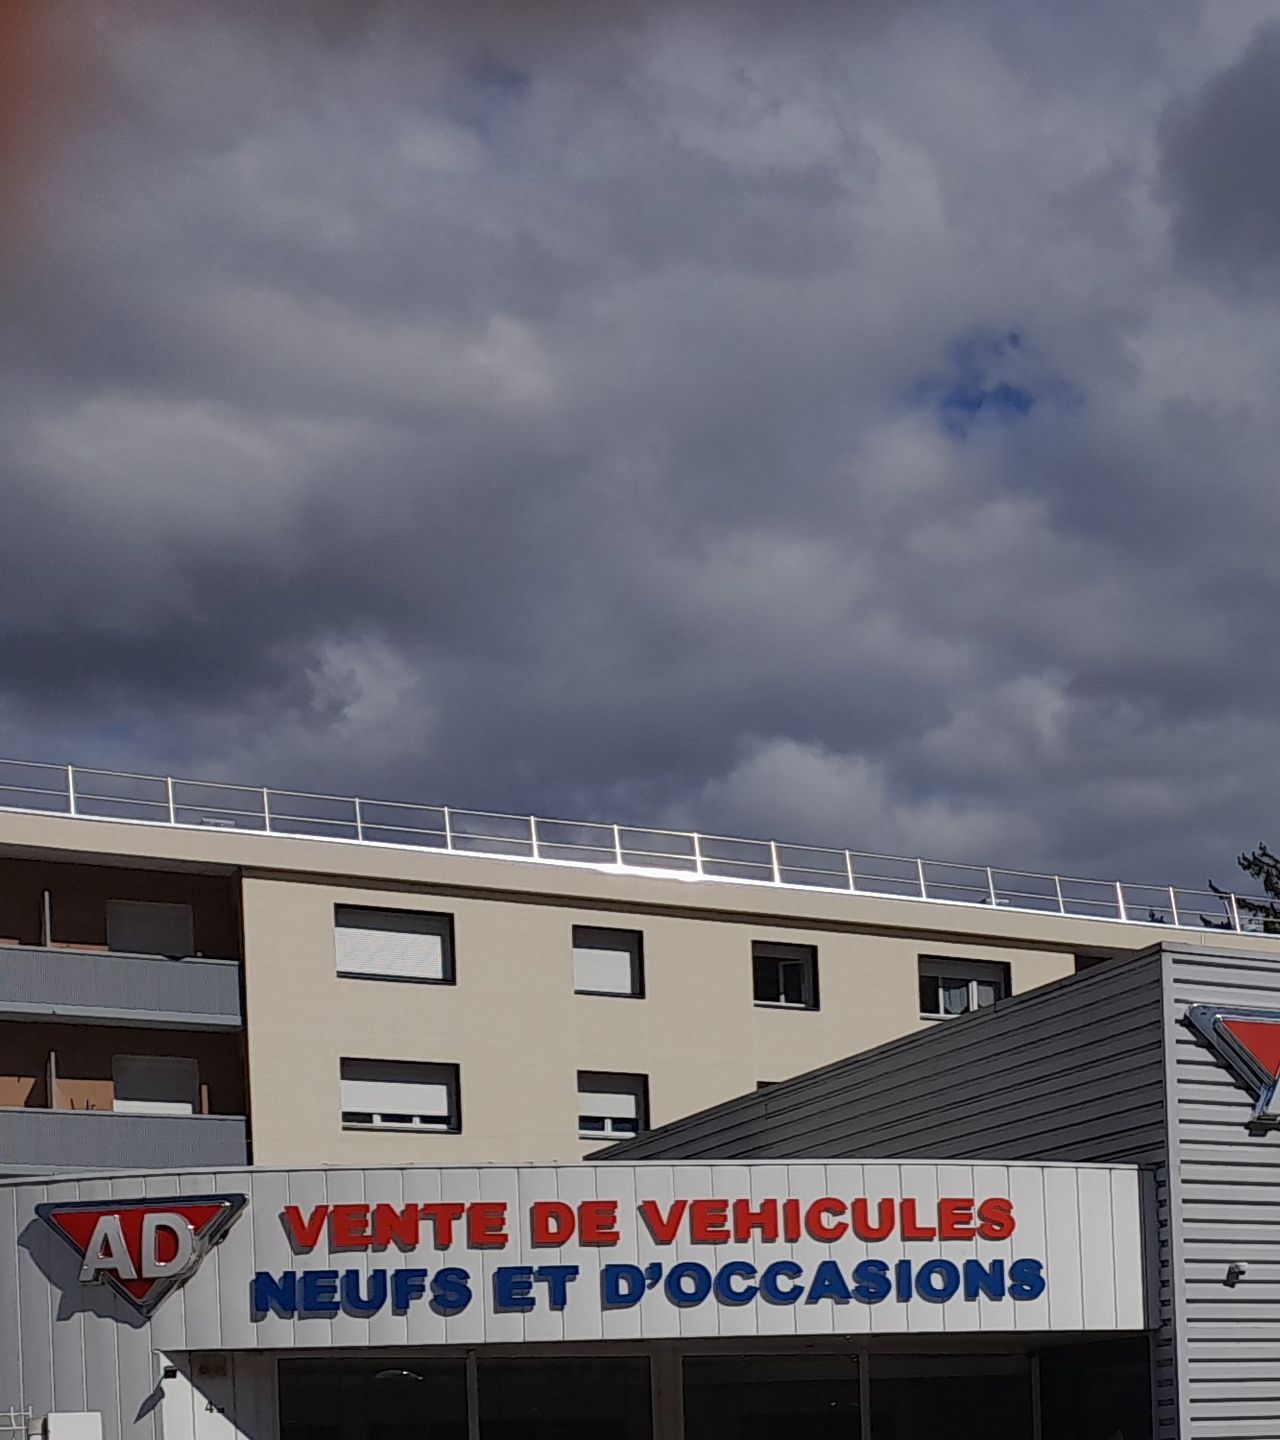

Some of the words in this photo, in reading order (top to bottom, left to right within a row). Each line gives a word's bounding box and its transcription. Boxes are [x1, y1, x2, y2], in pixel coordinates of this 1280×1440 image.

[79, 1212, 194, 1282] AD
[284, 1202, 509, 1248] VENTE
[531, 1200, 621, 1244] DE
[641, 1198, 1017, 1242] VEHICULES
[253, 1267, 472, 1318] NEUFS
[495, 1265, 579, 1311] ET
[604, 1258, 1047, 1307] D'OCCASIONS
